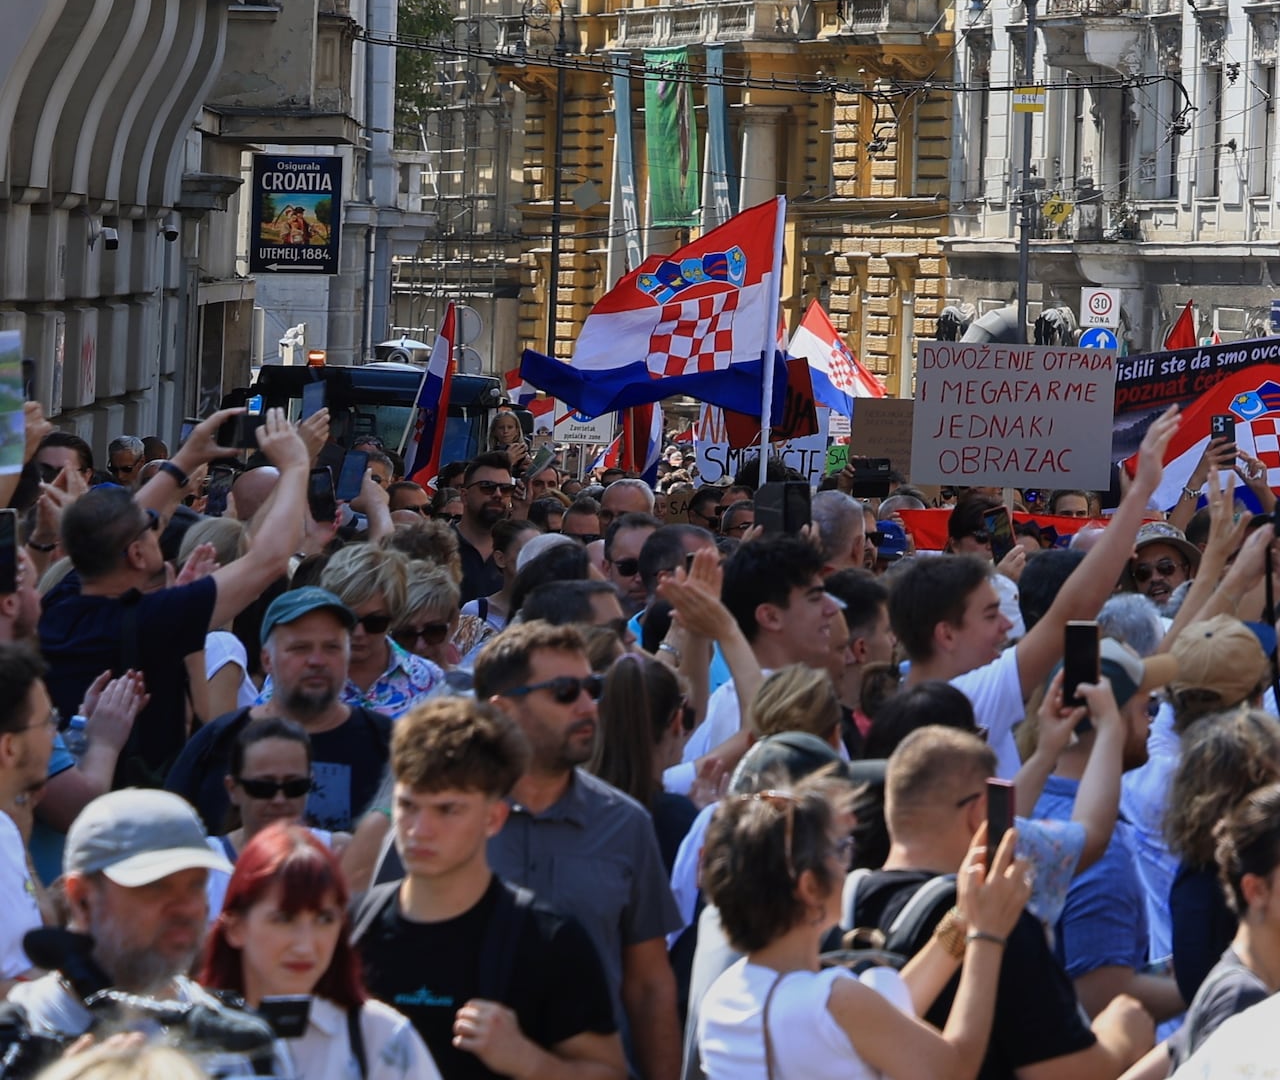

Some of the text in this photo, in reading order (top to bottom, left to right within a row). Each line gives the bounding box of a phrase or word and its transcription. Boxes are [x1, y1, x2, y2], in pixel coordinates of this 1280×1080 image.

[277, 161, 320, 172] Osigurala
[262, 172, 332, 191] CROATIA
[1050, 204, 1064, 215] 20
[1093, 297, 1108, 309] 30
[923, 346, 1112, 371] DOVOŽENJE OTPADA
[1116, 358, 1155, 382] islili
[1160, 355, 1186, 375] ste
[1190, 350, 1211, 370] da
[1216, 351, 1248, 366] smo
[921, 379, 1098, 404] I MEGAFARME
[933, 414, 1054, 439] JEDNAKI
[939, 446, 1073, 473] OBRAZAC
